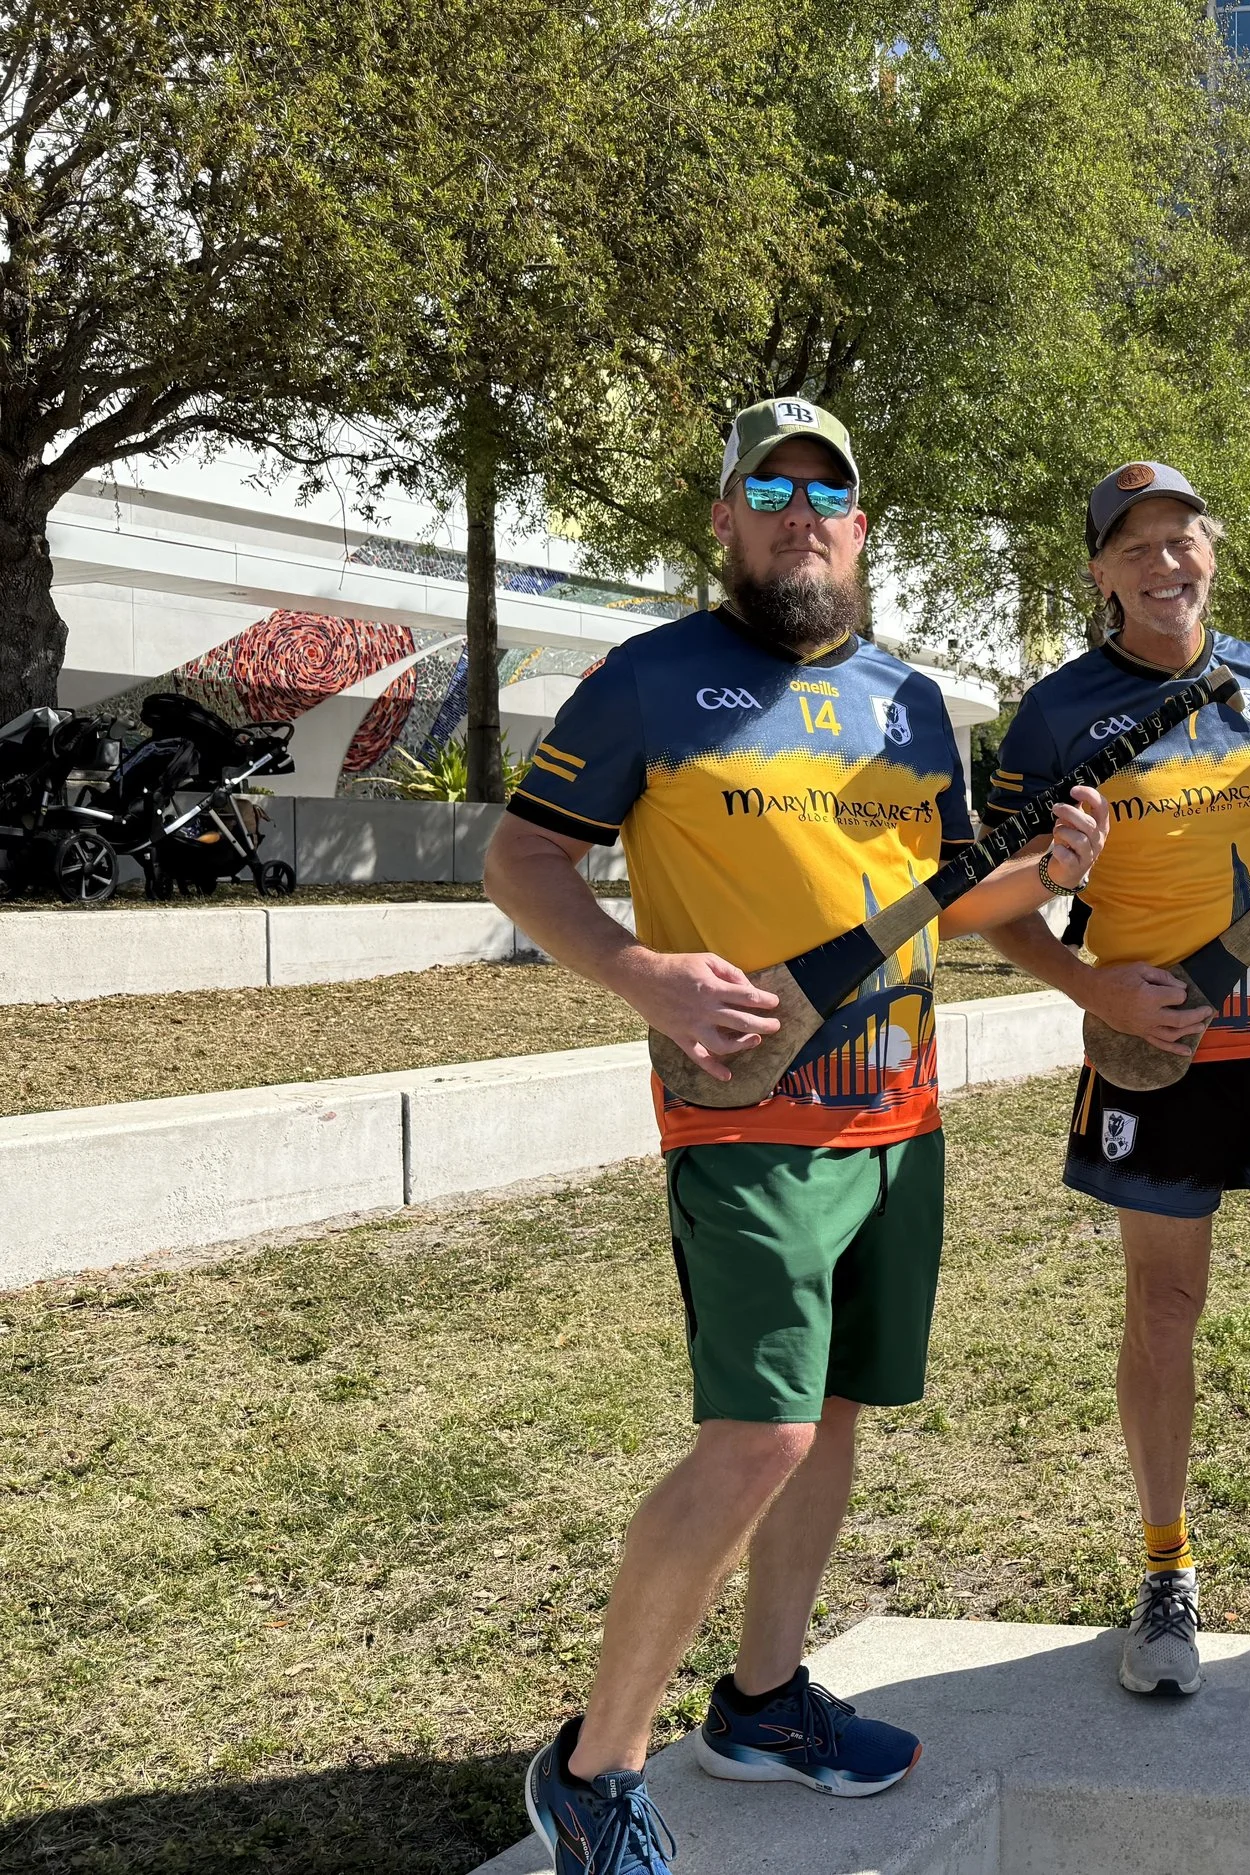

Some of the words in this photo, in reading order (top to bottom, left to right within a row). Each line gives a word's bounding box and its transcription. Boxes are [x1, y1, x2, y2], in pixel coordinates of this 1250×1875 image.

[778, 402, 814, 423] TB
[799, 696, 842, 736] 14
[1173, 806, 1201, 819] OLDE
[1206, 802, 1233, 815] IRISH
